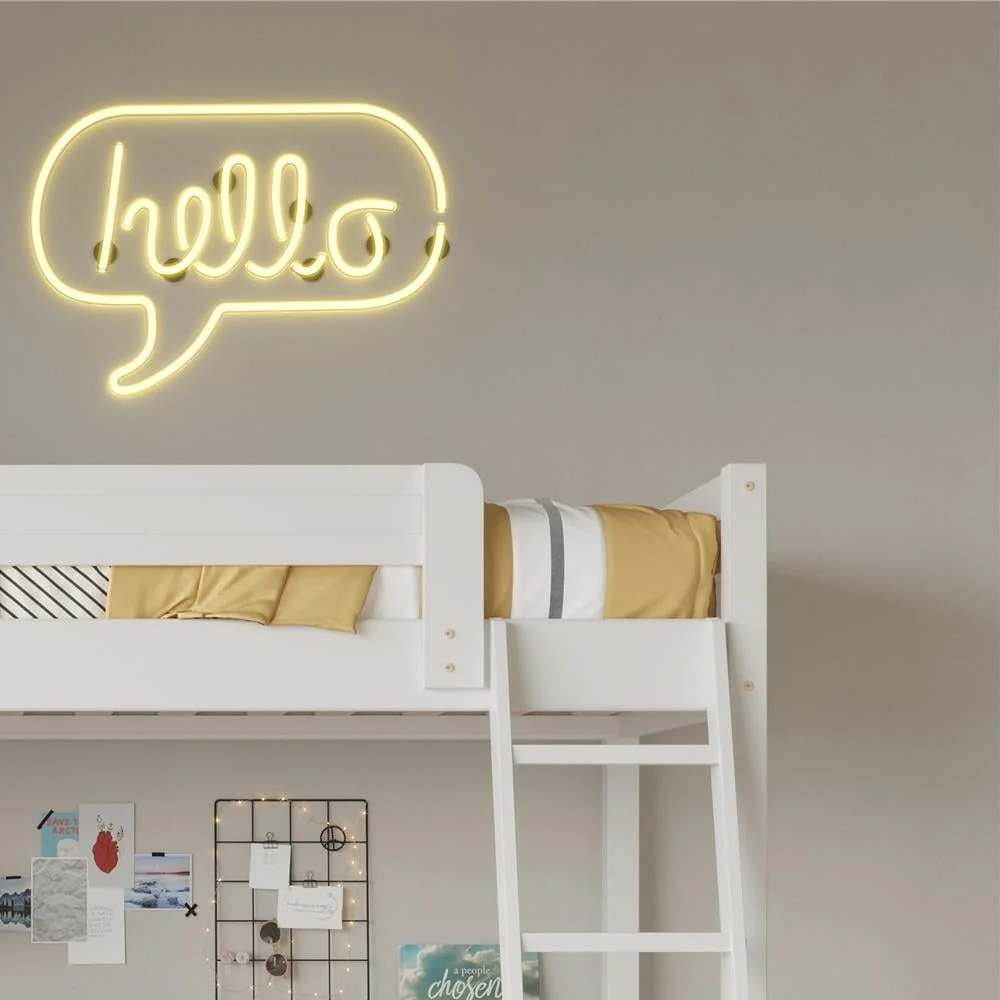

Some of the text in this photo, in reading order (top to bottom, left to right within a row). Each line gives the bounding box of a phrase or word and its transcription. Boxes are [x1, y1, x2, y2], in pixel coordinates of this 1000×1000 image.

[96, 141, 398, 279] hello
[52, 827, 79, 835] ARCTI
[462, 965, 490, 976] people
